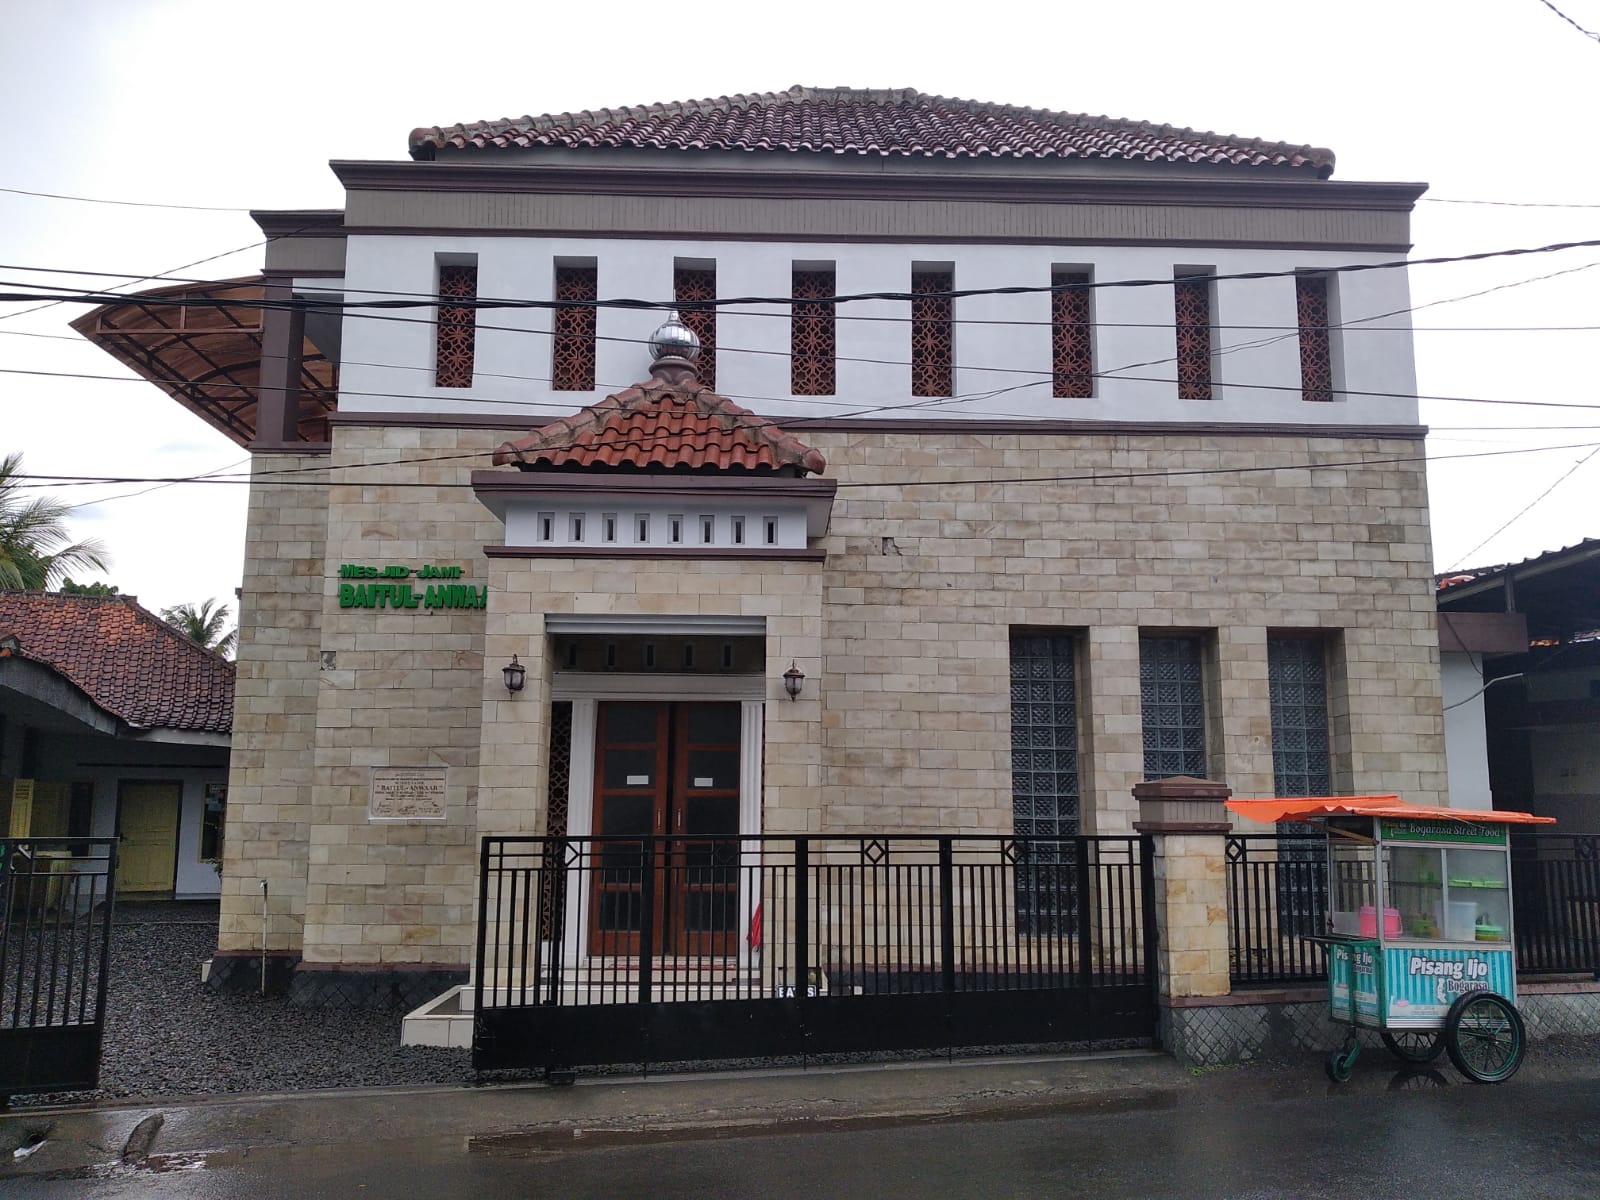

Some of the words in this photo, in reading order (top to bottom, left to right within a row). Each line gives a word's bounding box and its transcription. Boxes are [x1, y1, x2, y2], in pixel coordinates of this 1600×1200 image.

[340, 564, 409, 578] MESJID
[1410, 957, 1463, 979] Pisang
[1467, 958, 1487, 979] Ijo
[1447, 980, 1488, 993] Bogarasa
